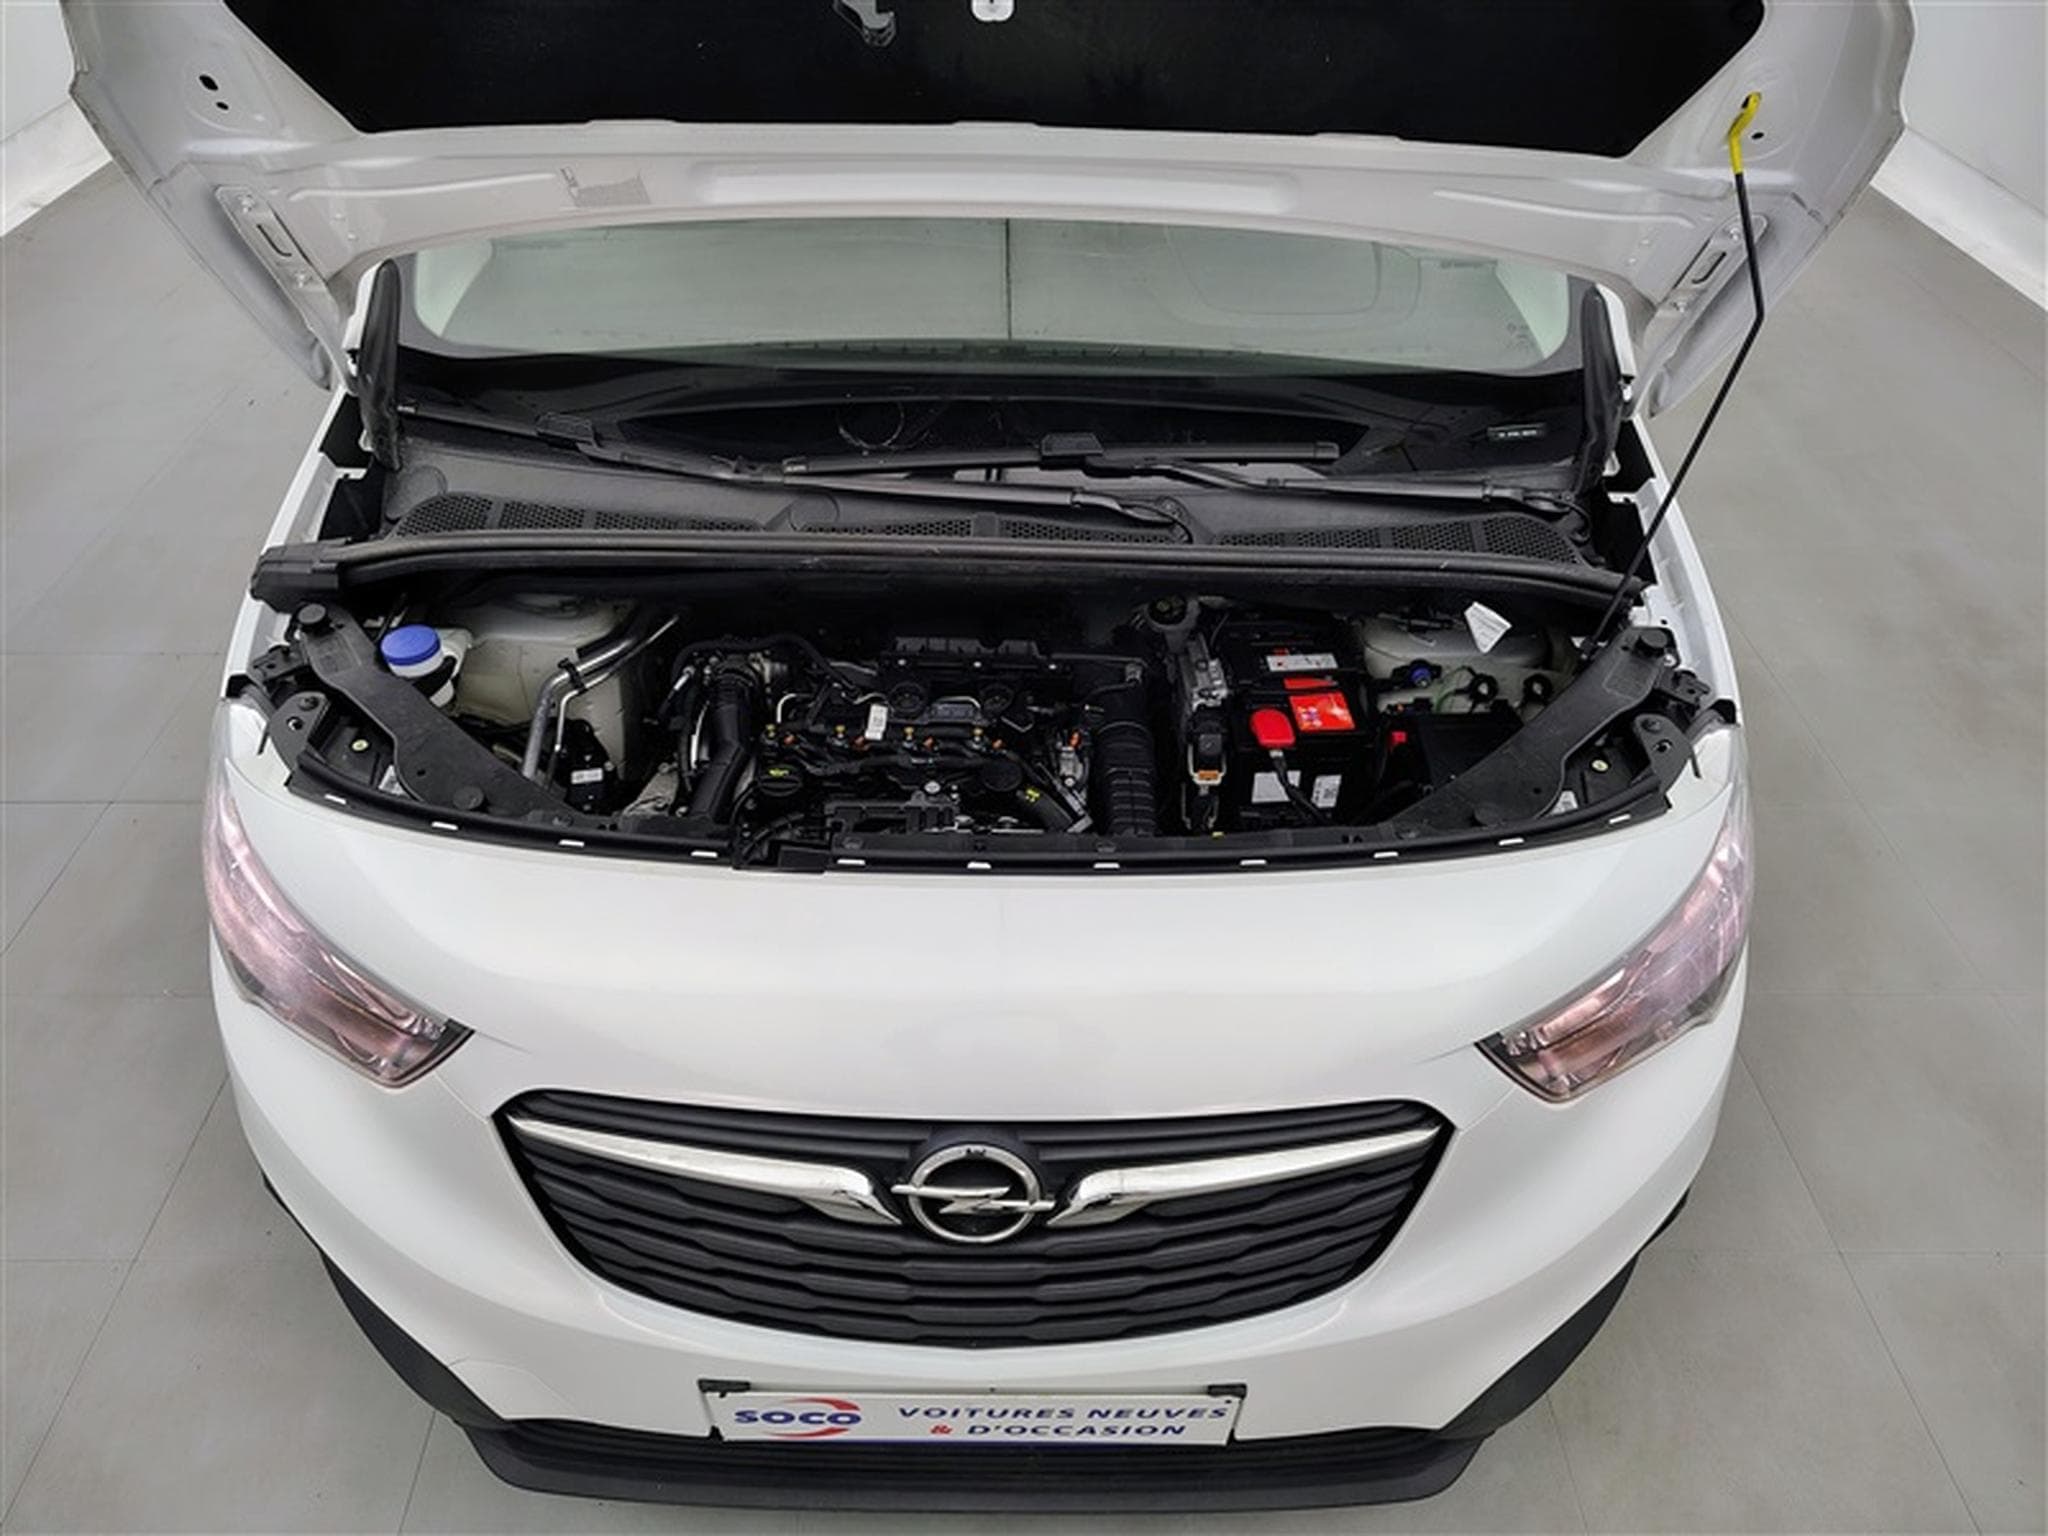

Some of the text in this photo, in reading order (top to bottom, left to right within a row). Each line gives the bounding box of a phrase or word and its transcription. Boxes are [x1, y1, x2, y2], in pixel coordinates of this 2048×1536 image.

[734, 1410, 862, 1425] SOCO
[899, 1407, 1228, 1419] VOITURES NEUVES
[929, 1424, 1186, 1436] & D'OCCASION
